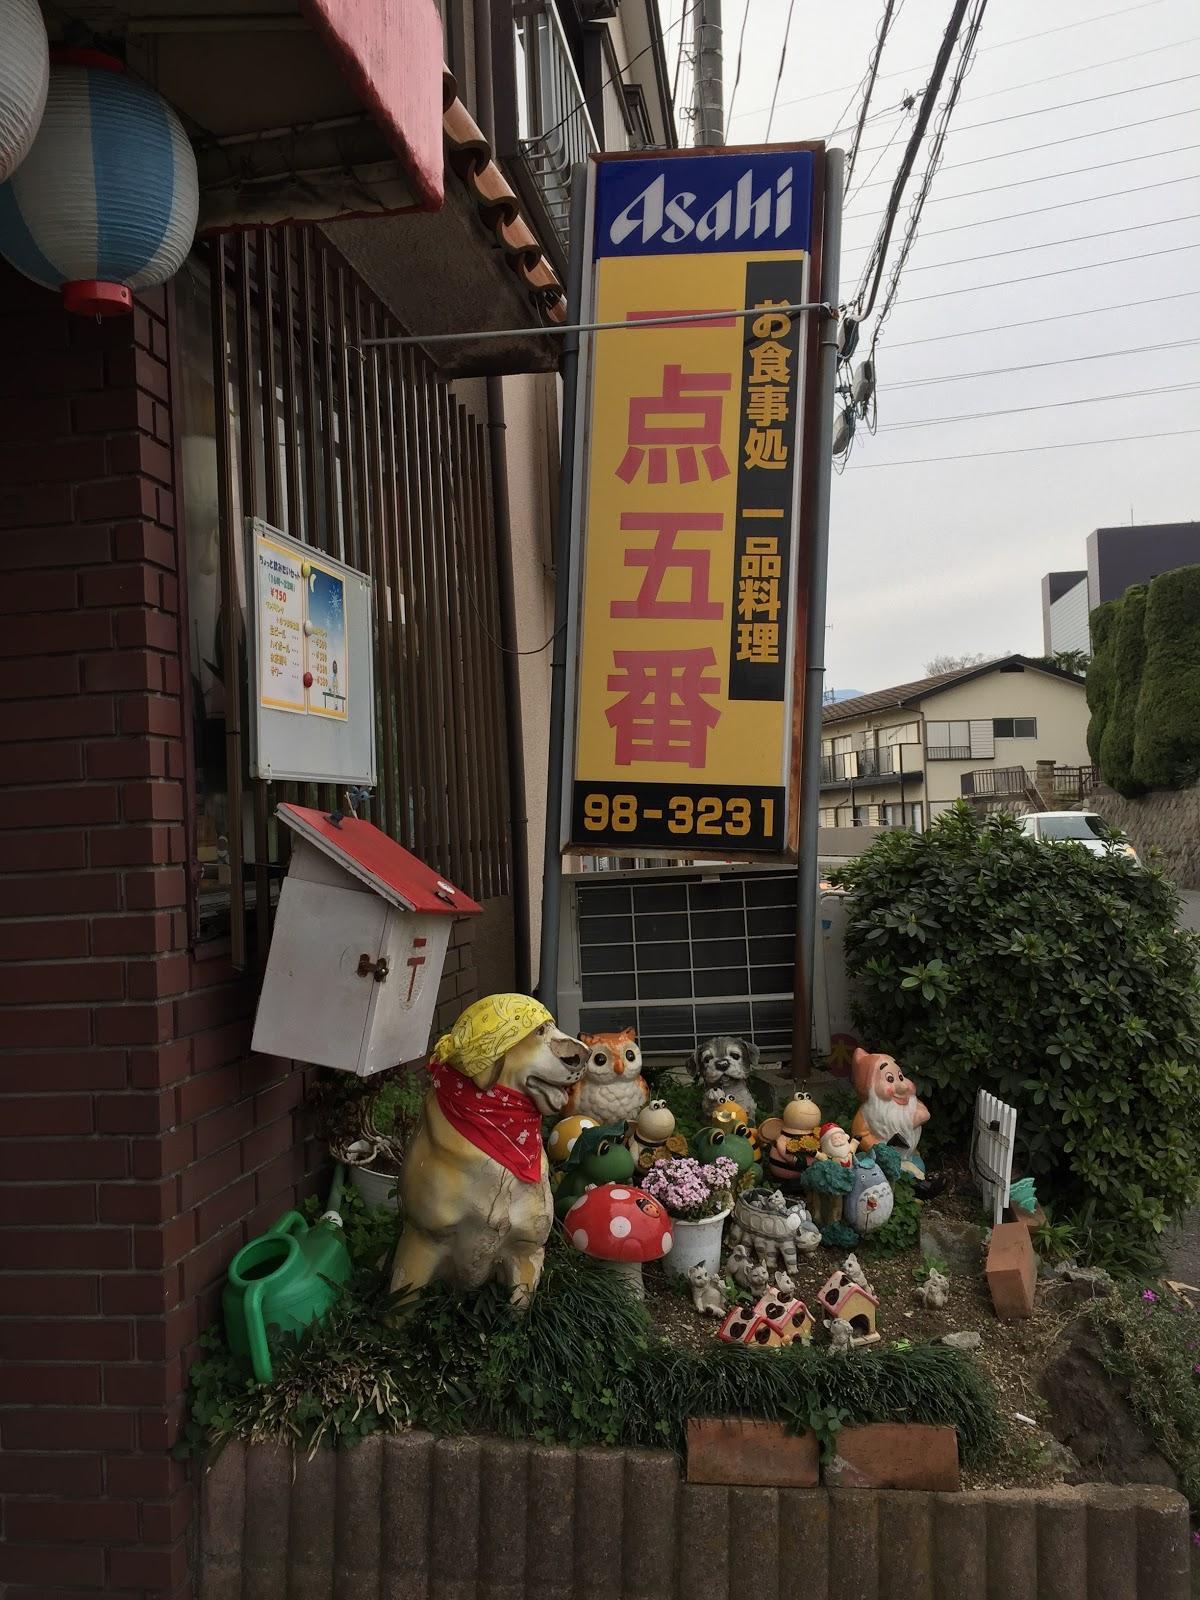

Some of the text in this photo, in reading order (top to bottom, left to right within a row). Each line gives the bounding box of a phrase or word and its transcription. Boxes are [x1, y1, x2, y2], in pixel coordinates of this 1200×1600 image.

[610, 166, 793, 245] Asahi
[604, 309, 737, 769] 一点五番
[736, 299, 793, 663] お食事処 一品料理
[583, 794, 775, 837] 98-3231
